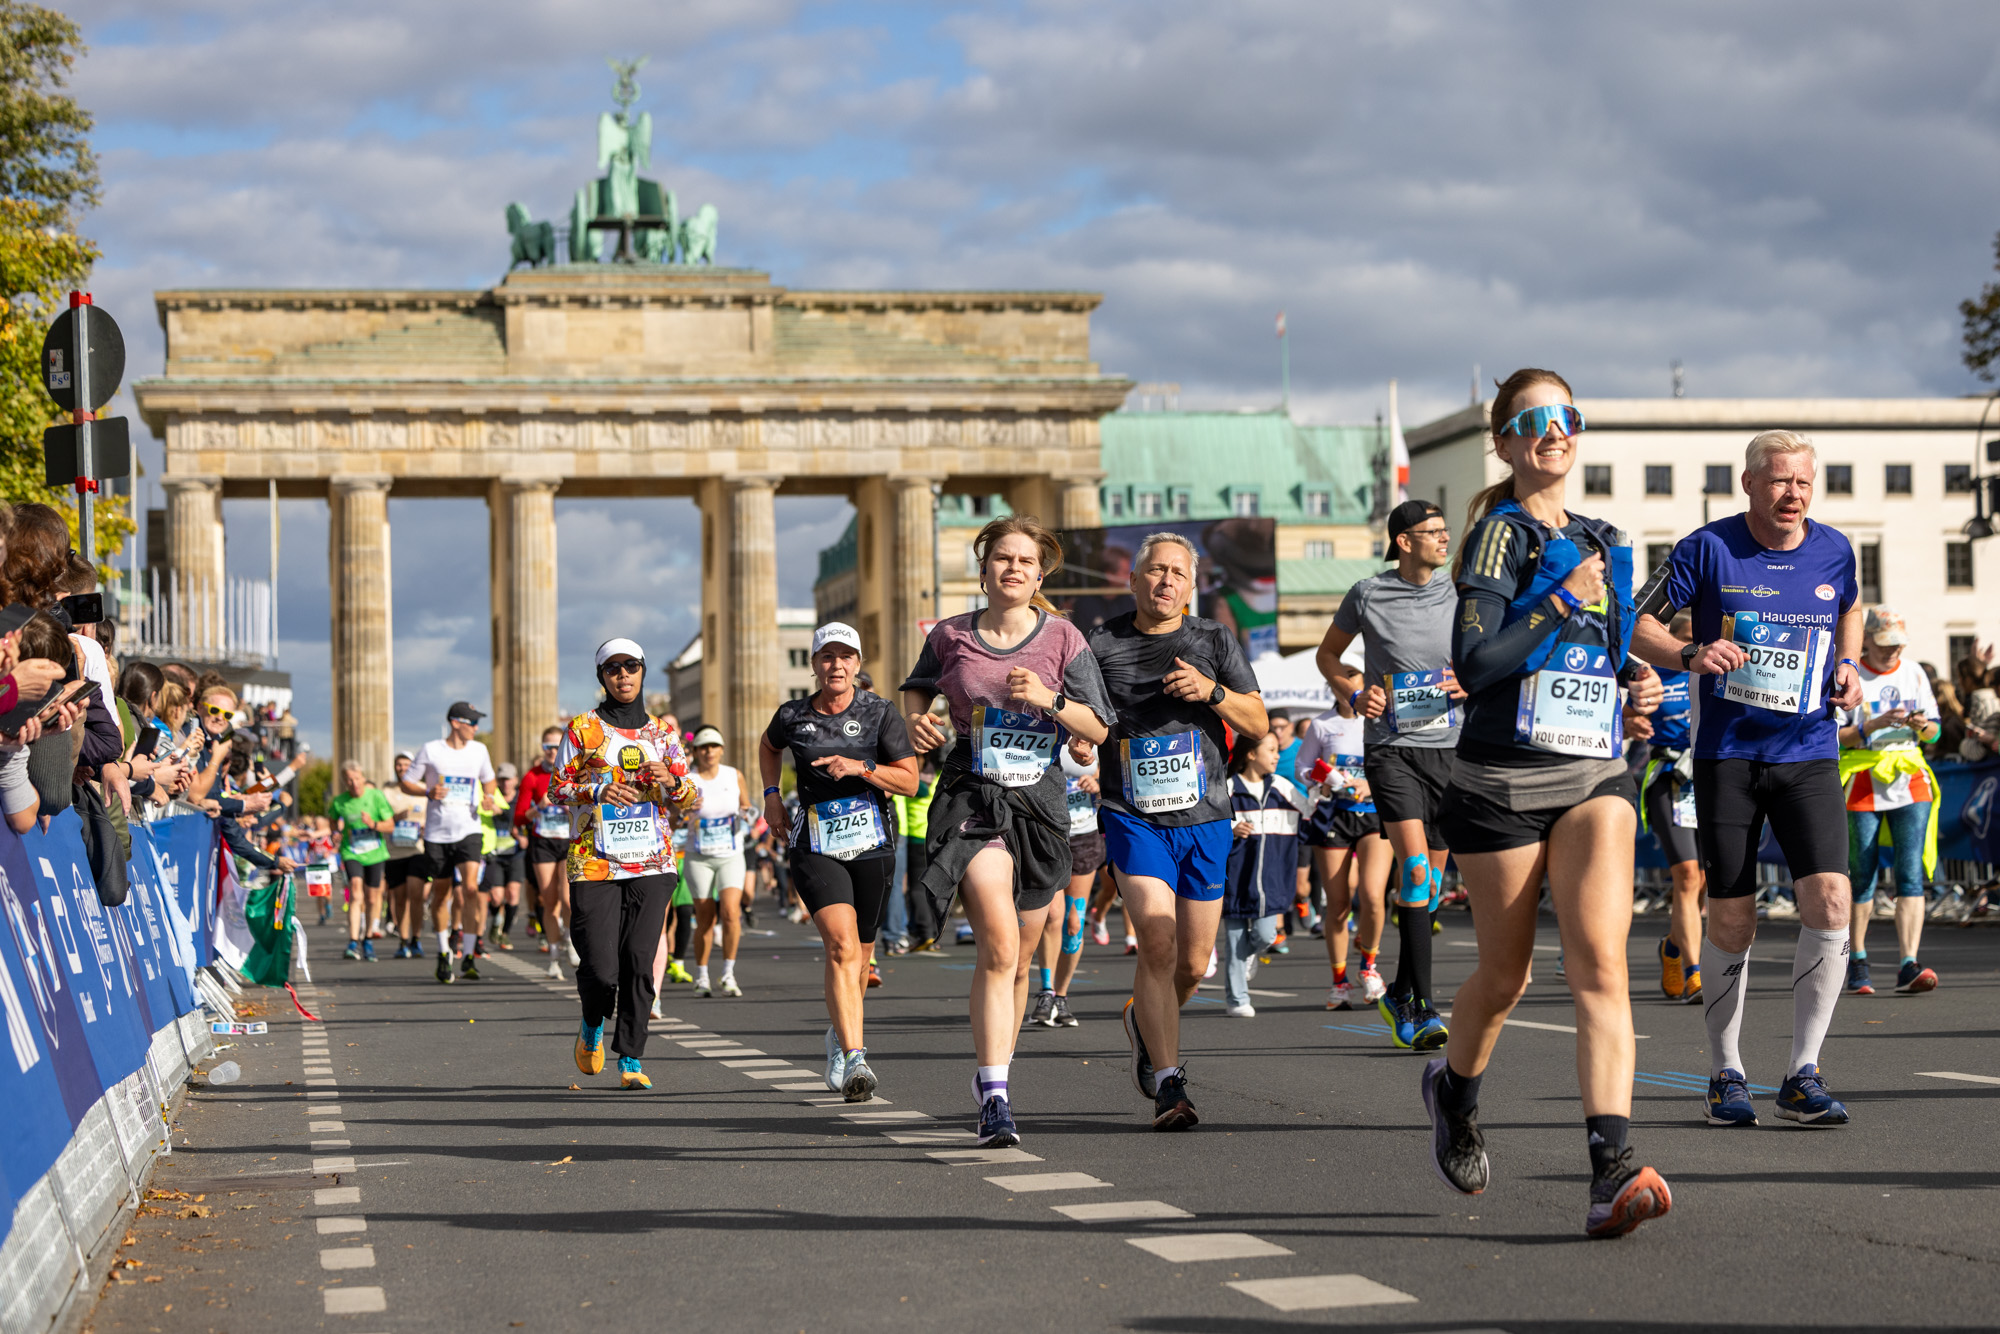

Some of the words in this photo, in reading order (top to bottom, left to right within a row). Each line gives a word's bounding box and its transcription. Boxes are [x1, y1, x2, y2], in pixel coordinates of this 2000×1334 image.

[1762, 611, 1833, 624] Haugesund
[823, 628, 852, 639] HOKA
[1756, 669, 1777, 679] Rune
[1263, 688, 1331, 702] RDINGER
[1397, 687, 1443, 704] 58242
[1550, 677, 1609, 704] 62191
[1727, 685, 1743, 697] YOU
[1744, 690, 1760, 701] GOT
[1761, 693, 1780, 704] THIS
[1566, 705, 1594, 718] Svenja
[1398, 721, 1409, 729] YOU
[1411, 720, 1422, 728] GOT
[989, 732, 1049, 751] 67474
[1535, 731, 1555, 743] YOU
[1557, 733, 1576, 746] GOT
[1577, 736, 1593, 748] THIS
[624, 758, 639, 766] MSG
[1005, 752, 1031, 761] Bianca
[1137, 755, 1191, 777] 63304
[984, 772, 1000, 781] YOU
[1002, 773, 1016, 782] GOT
[1016, 773, 1031, 782] THIS
[1152, 777, 1180, 785] Markus
[1067, 791, 1087, 805] 869
[1135, 800, 1150, 809] YOU
[1151, 798, 1166, 807] GOT
[1166, 796, 1184, 806] THIS
[608, 820, 650, 835] 79782
[825, 812, 868, 835] 22745
[835, 830, 862, 841] Susanne
[620, 851, 631, 860] GOT
[632, 850, 645, 858] THIS
[838, 850, 851, 859] GOT
[852, 847, 865, 856] THIS
